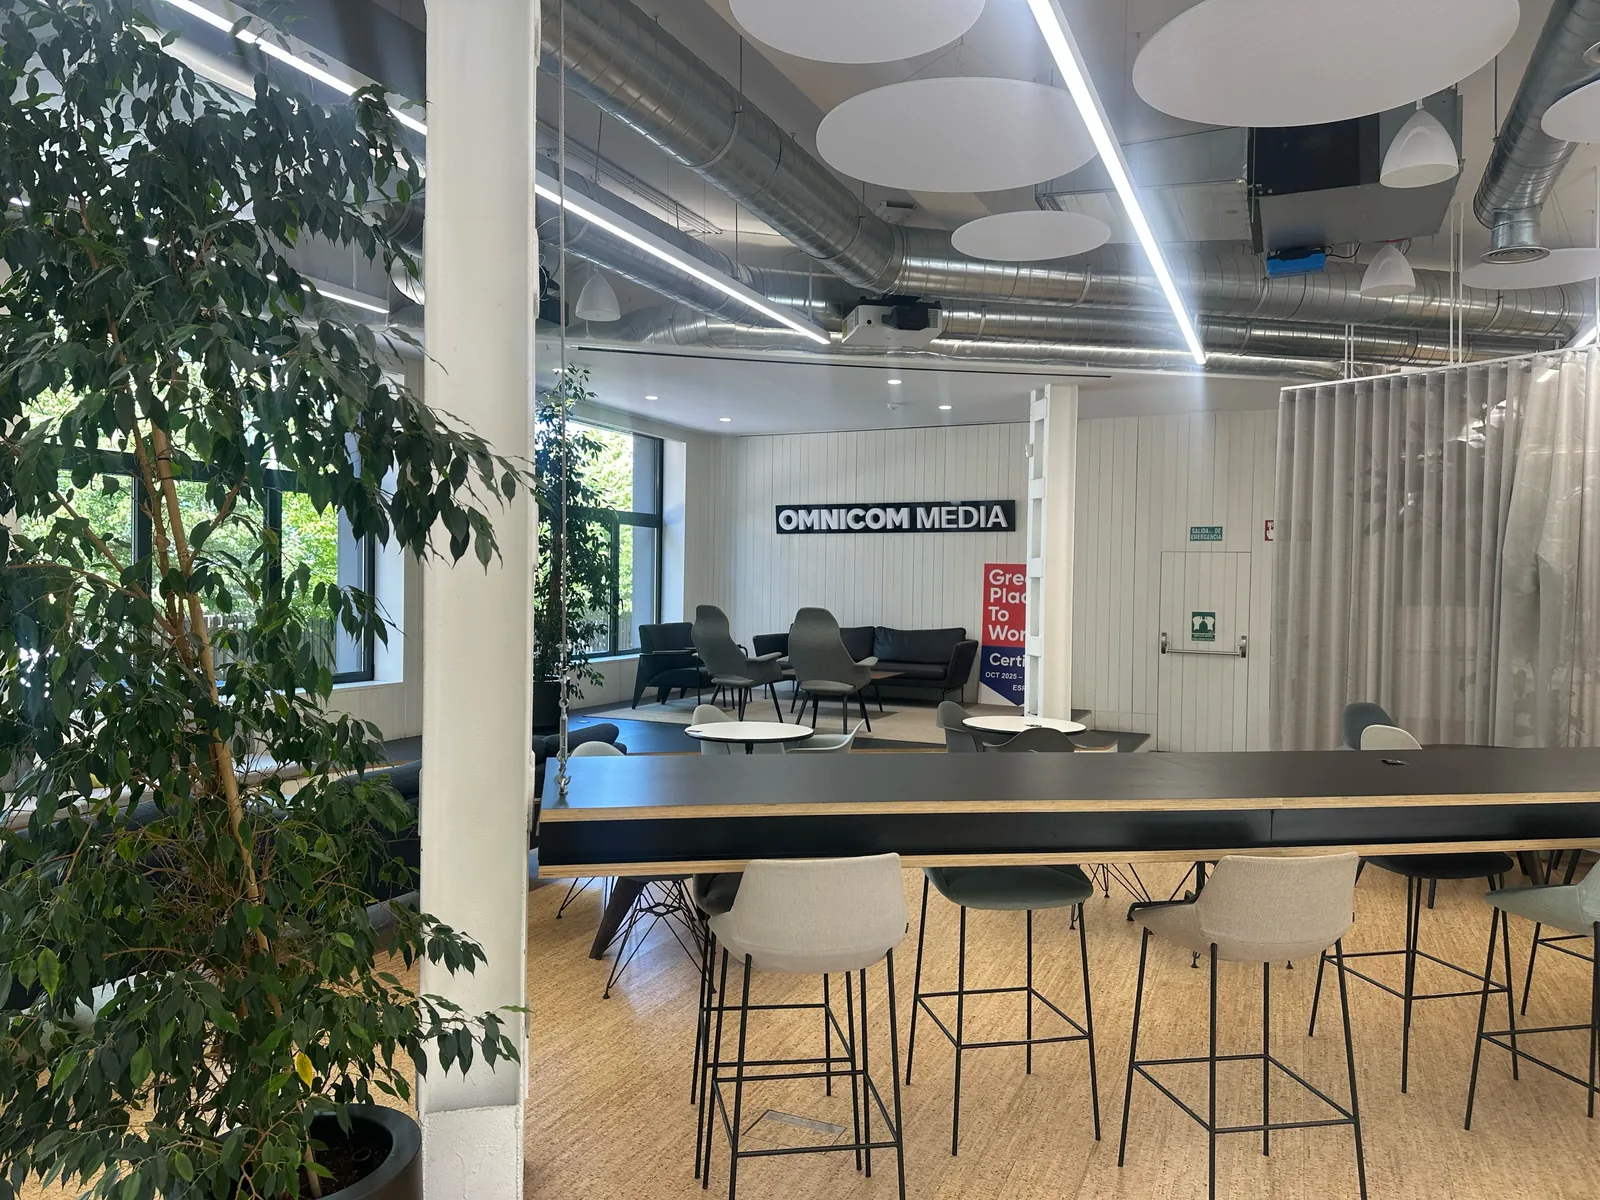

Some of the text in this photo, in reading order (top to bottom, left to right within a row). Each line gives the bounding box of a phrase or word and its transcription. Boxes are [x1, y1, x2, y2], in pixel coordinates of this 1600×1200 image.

[778, 505, 1008, 530] OMNICOM MEDIA
[989, 569, 1027, 585] Gre
[988, 606, 1009, 622] To
[1001, 672, 1017, 680] 2025
